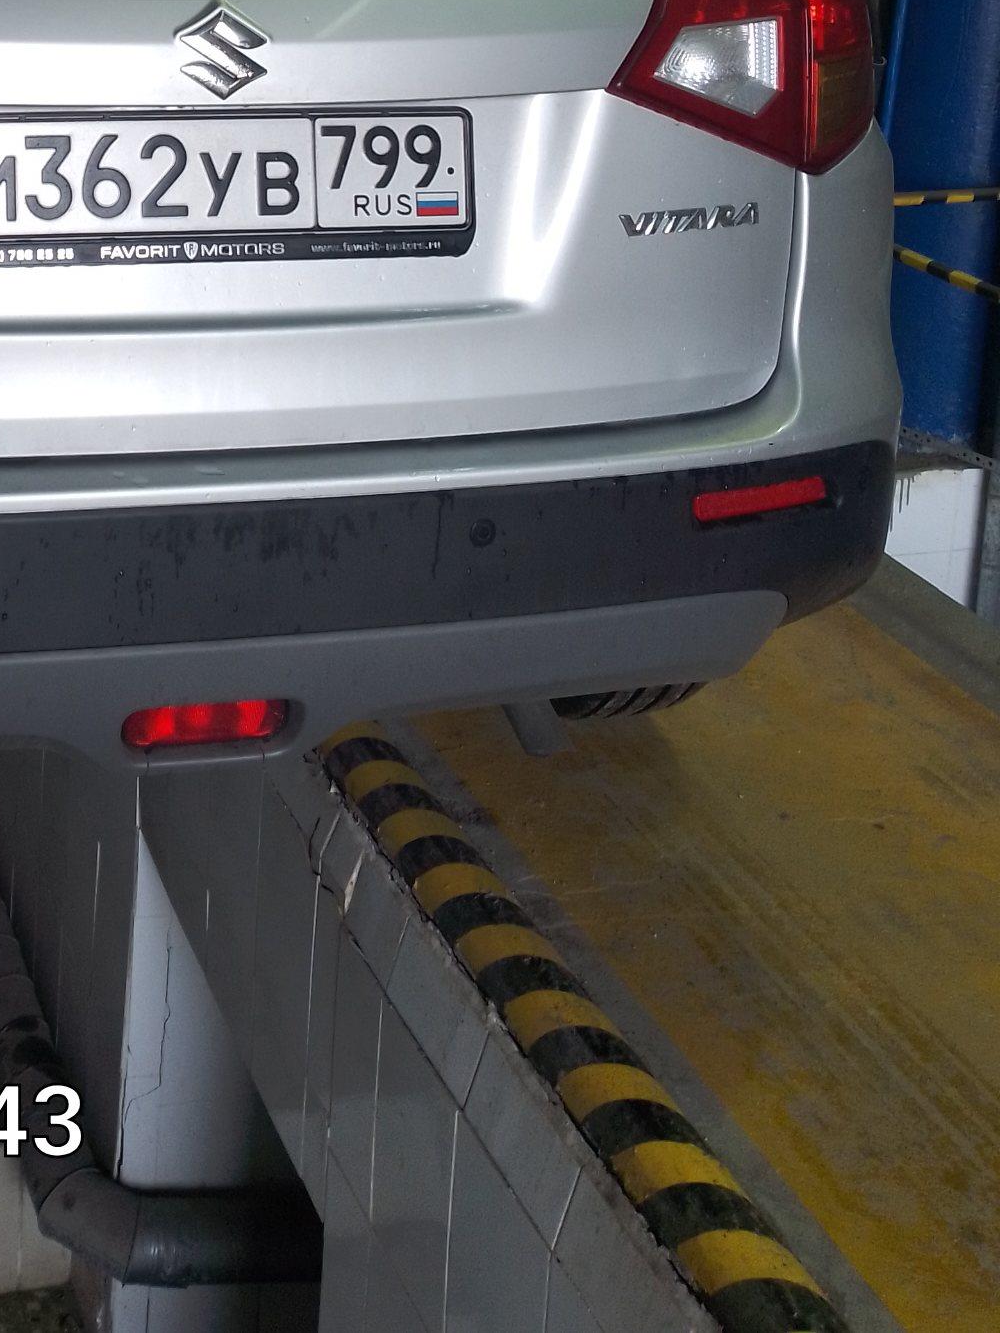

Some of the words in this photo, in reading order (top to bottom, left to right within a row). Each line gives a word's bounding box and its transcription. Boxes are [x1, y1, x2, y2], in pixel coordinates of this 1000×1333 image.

[320, 124, 442, 189] 799
[354, 193, 412, 217] RUS
[618, 202, 760, 237] VITARA
[99, 244, 181, 260] FAVORIT
[200, 242, 285, 258] MOTORS
